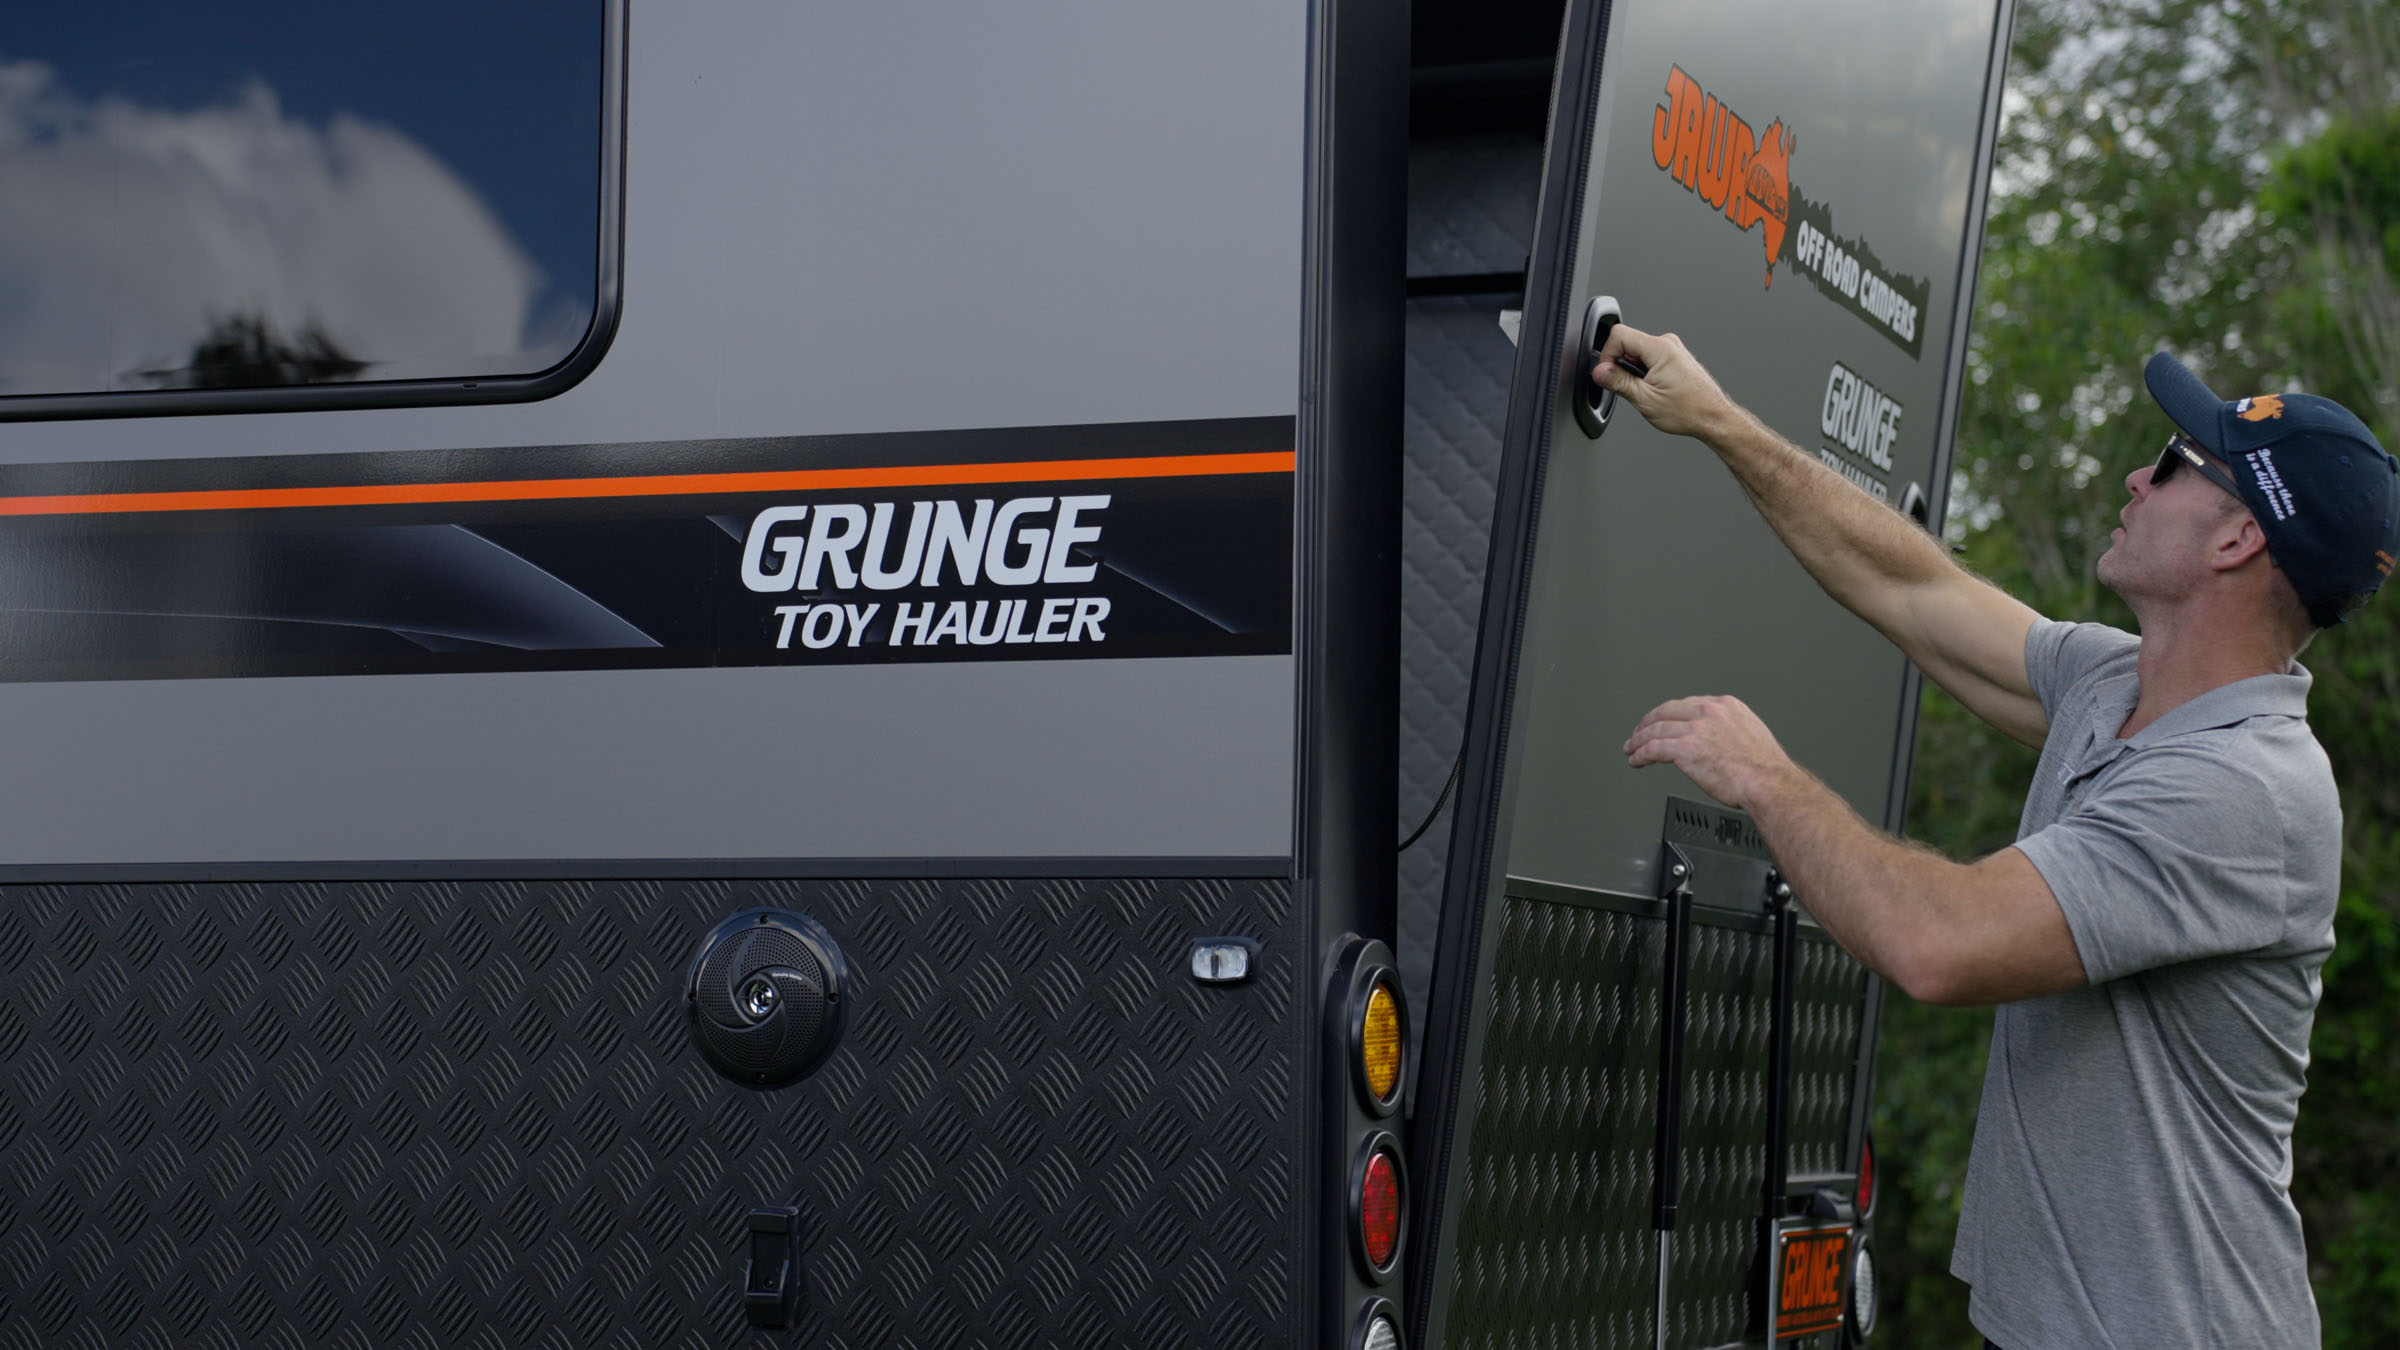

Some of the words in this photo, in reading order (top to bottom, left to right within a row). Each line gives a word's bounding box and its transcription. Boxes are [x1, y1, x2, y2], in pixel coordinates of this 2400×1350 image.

[1797, 220, 1825, 271] OFF
[1822, 239, 1860, 299] ROAD
[1860, 269, 1918, 343] CAMPERS
[1820, 362, 1902, 472] GRUNGE
[2255, 470, 2287, 521] difference
[2257, 448, 2284, 489] Because
[2278, 488, 2297, 516] there
[741, 495, 1111, 593] GRUNGE
[774, 602, 881, 649] TOY
[889, 597, 1111, 647] HAULER
[1782, 1237, 1846, 1312] GRUNGE
